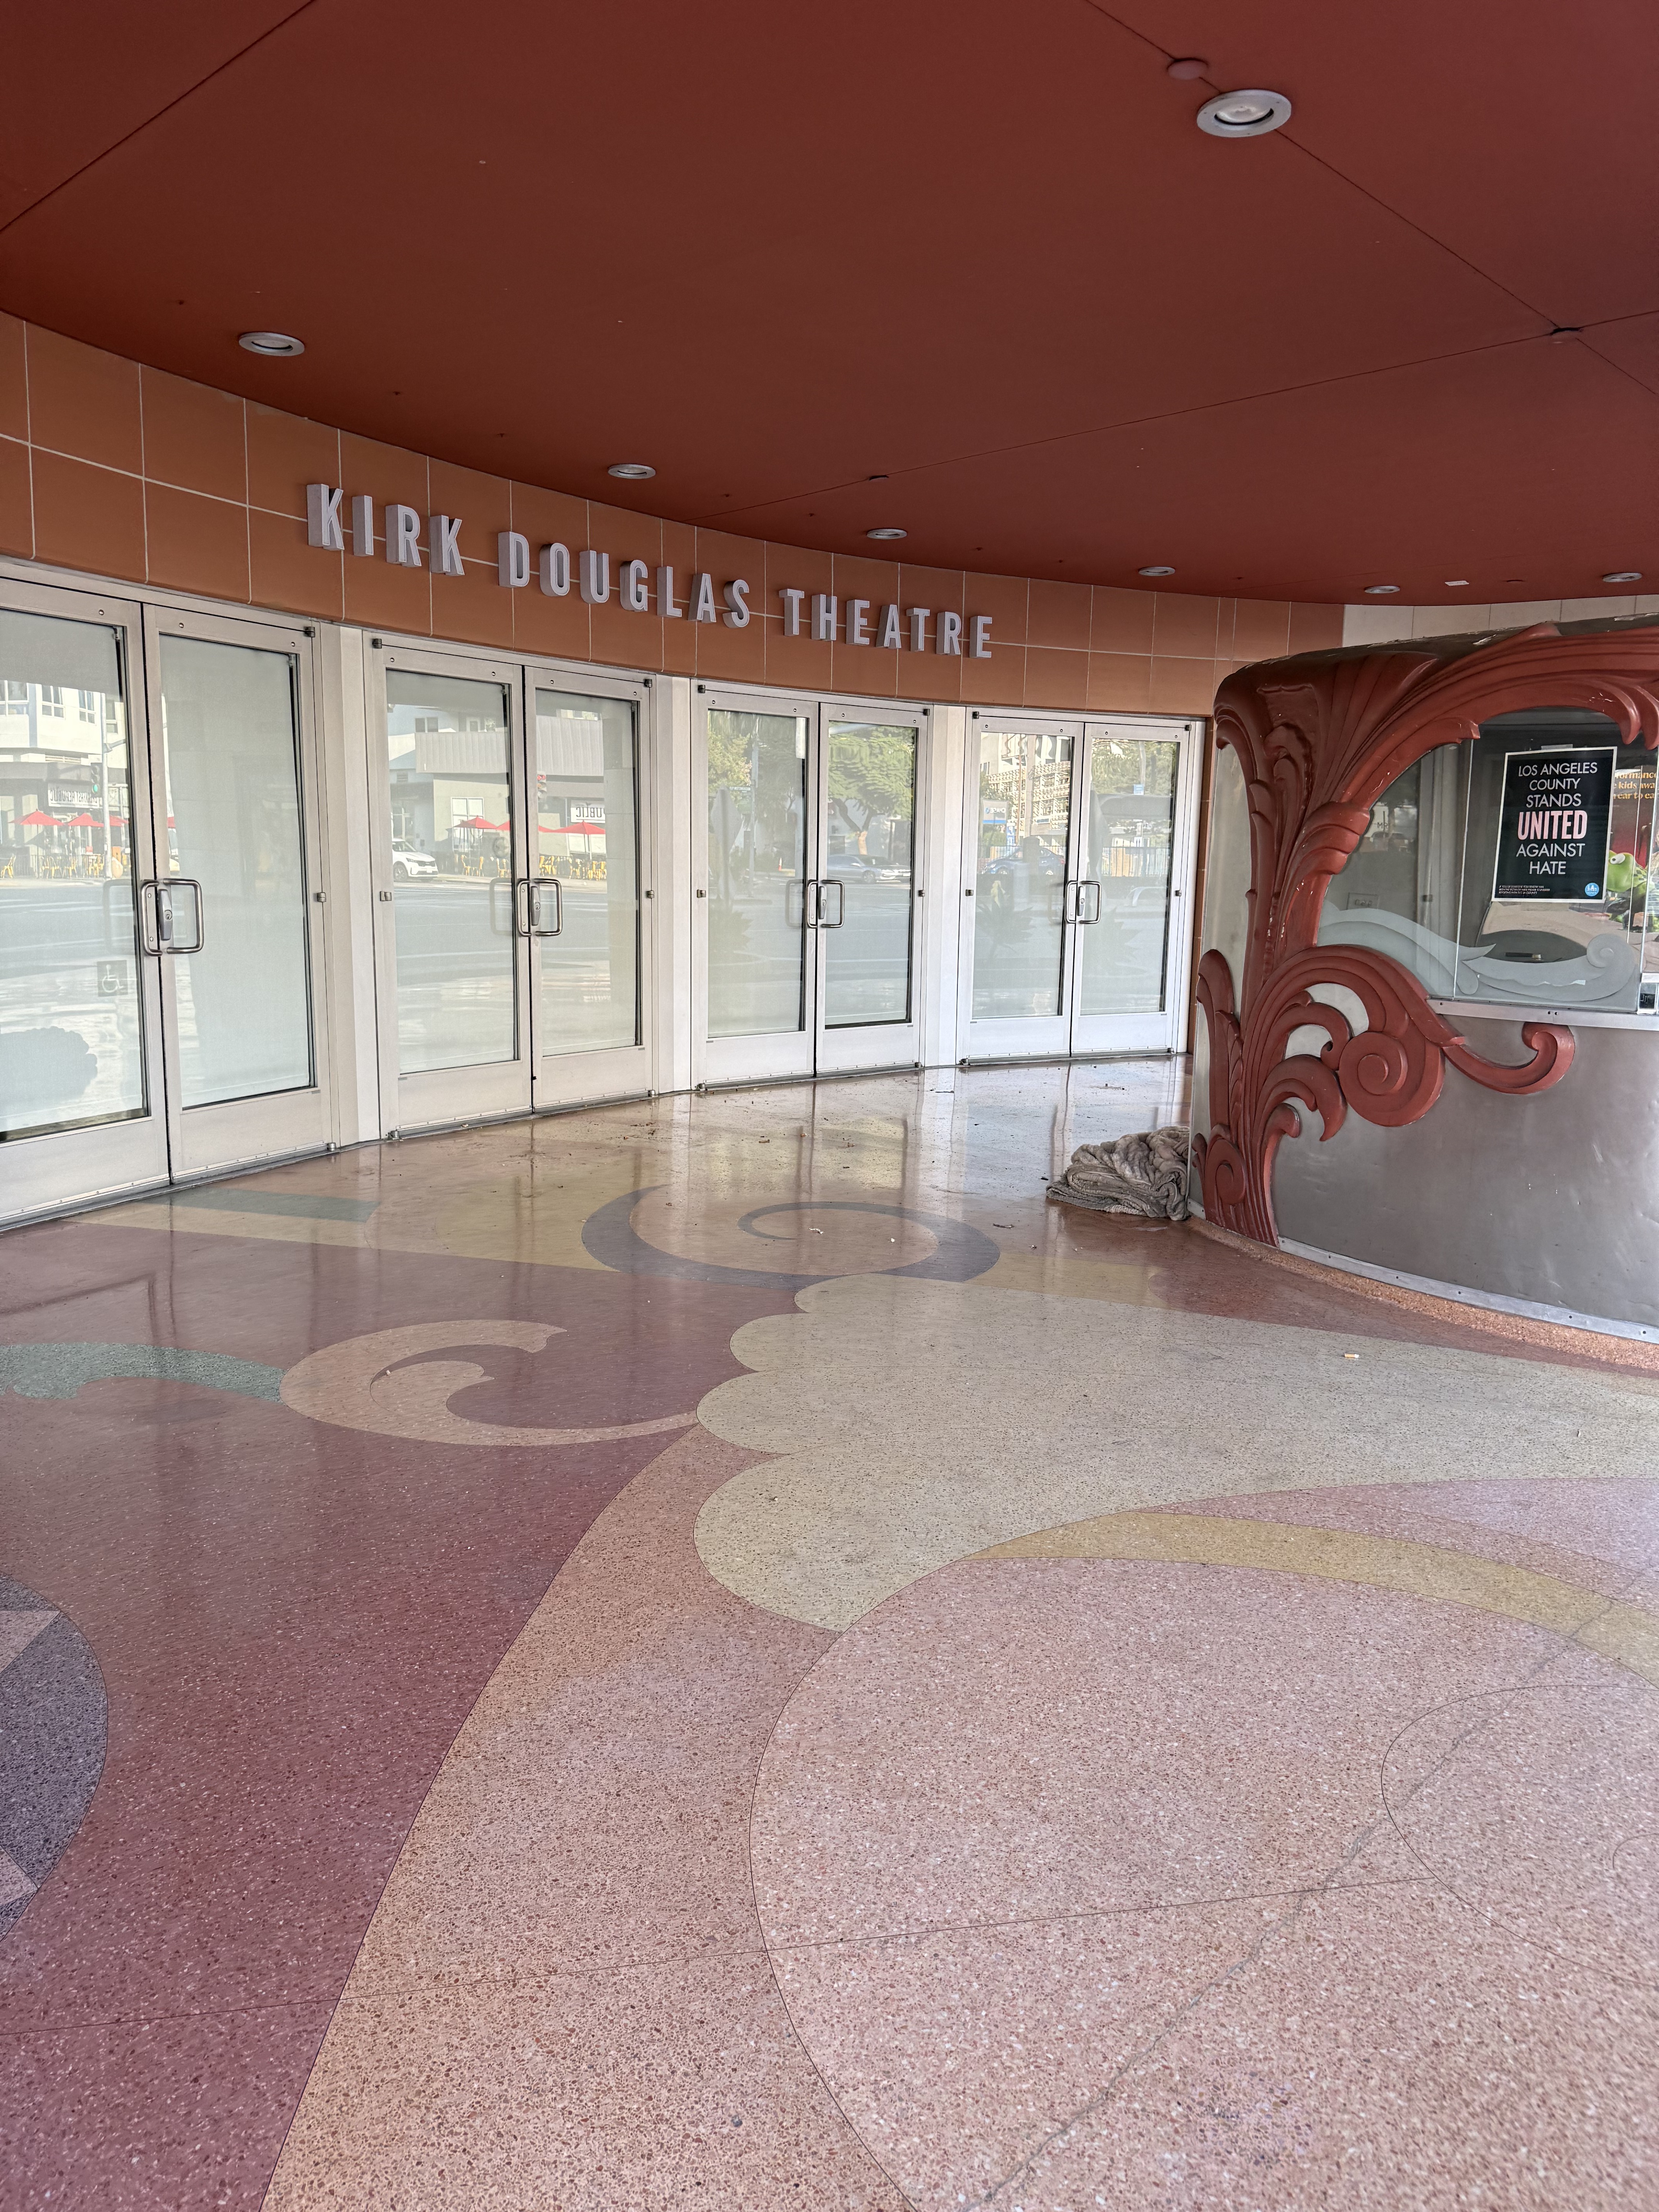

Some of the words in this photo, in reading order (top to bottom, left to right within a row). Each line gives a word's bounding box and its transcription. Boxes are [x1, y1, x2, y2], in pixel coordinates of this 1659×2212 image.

[307, 484, 465, 576] KIRK
[498, 531, 749, 628] DOUGLAS
[779, 589, 992, 658] THEATRE
[1518, 765, 1537, 776] LOS
[1540, 762, 1597, 775] ANGELES
[1530, 778, 1580, 790] COUNTY
[1526, 793, 1581, 807] STANDS
[1518, 810, 1587, 840] UNITED
[1516, 843, 1585, 857] AGAINST
[1529, 861, 1566, 874] HATE
